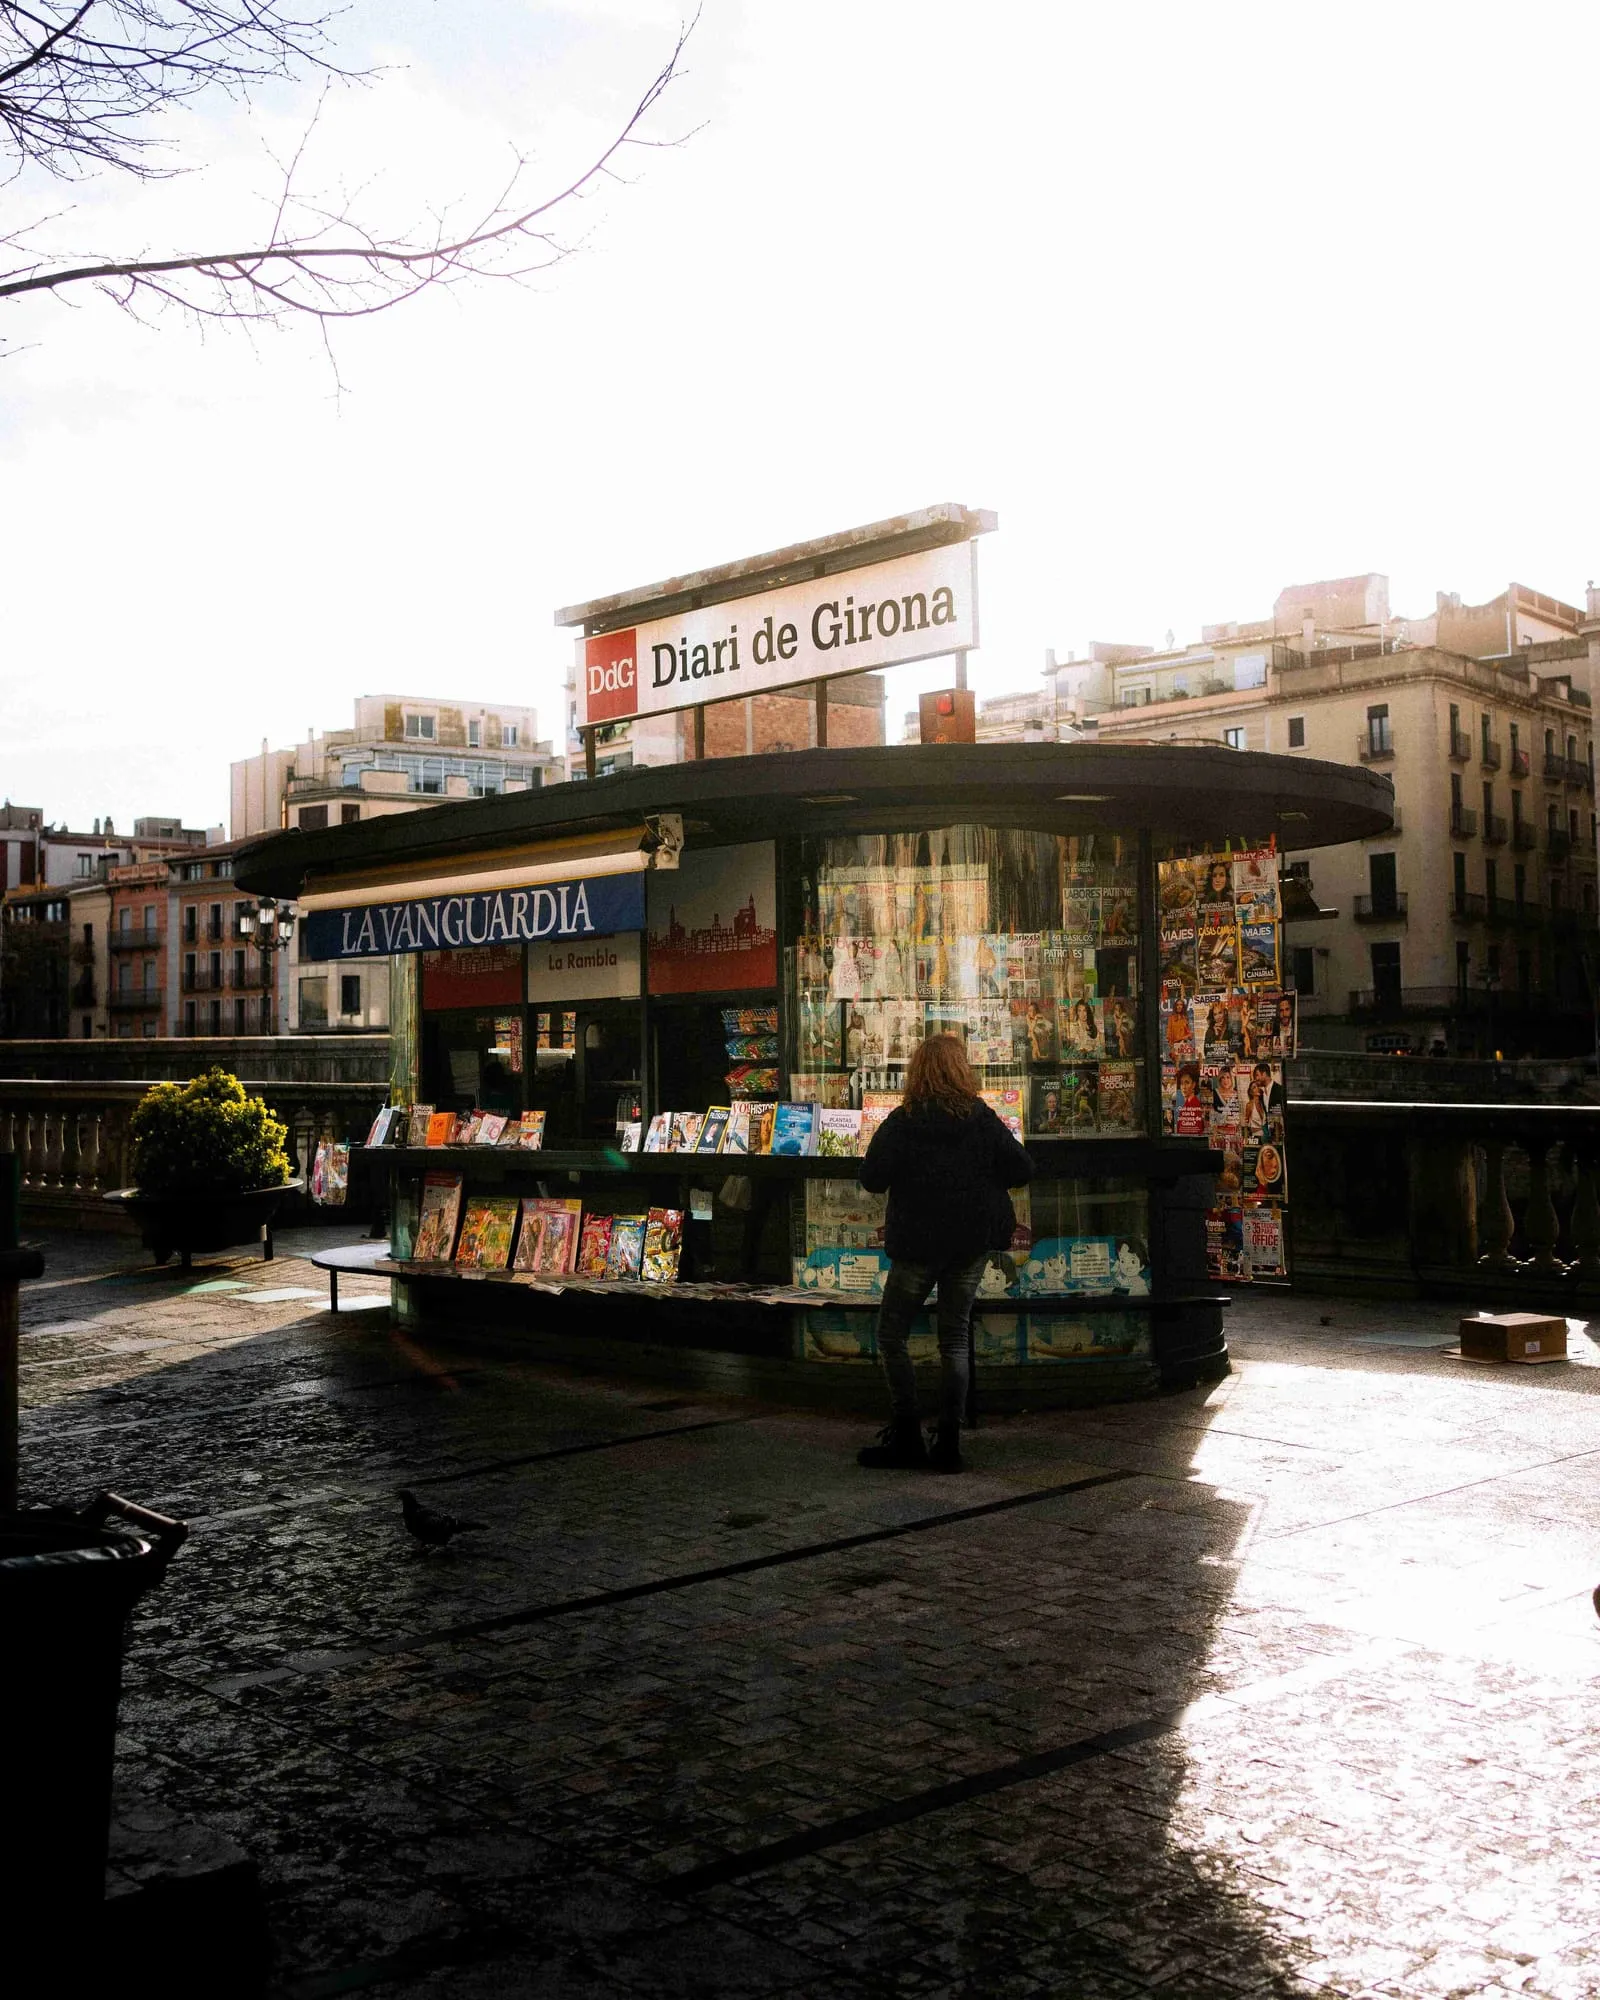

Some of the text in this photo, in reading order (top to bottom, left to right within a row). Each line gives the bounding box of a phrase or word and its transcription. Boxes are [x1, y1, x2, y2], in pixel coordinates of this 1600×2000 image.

[652, 586, 957, 688] Diari de Girona
[587, 658, 635, 696] DdG
[340, 881, 596, 954] LA VANGUARDIA
[1161, 928, 1195, 943] VIAJES
[1246, 926, 1272, 938] VIAJES
[548, 947, 618, 971] La Rambla
[829, 1116, 852, 1124] PLANTAS
[1252, 1234, 1279, 1247] OFFICE
